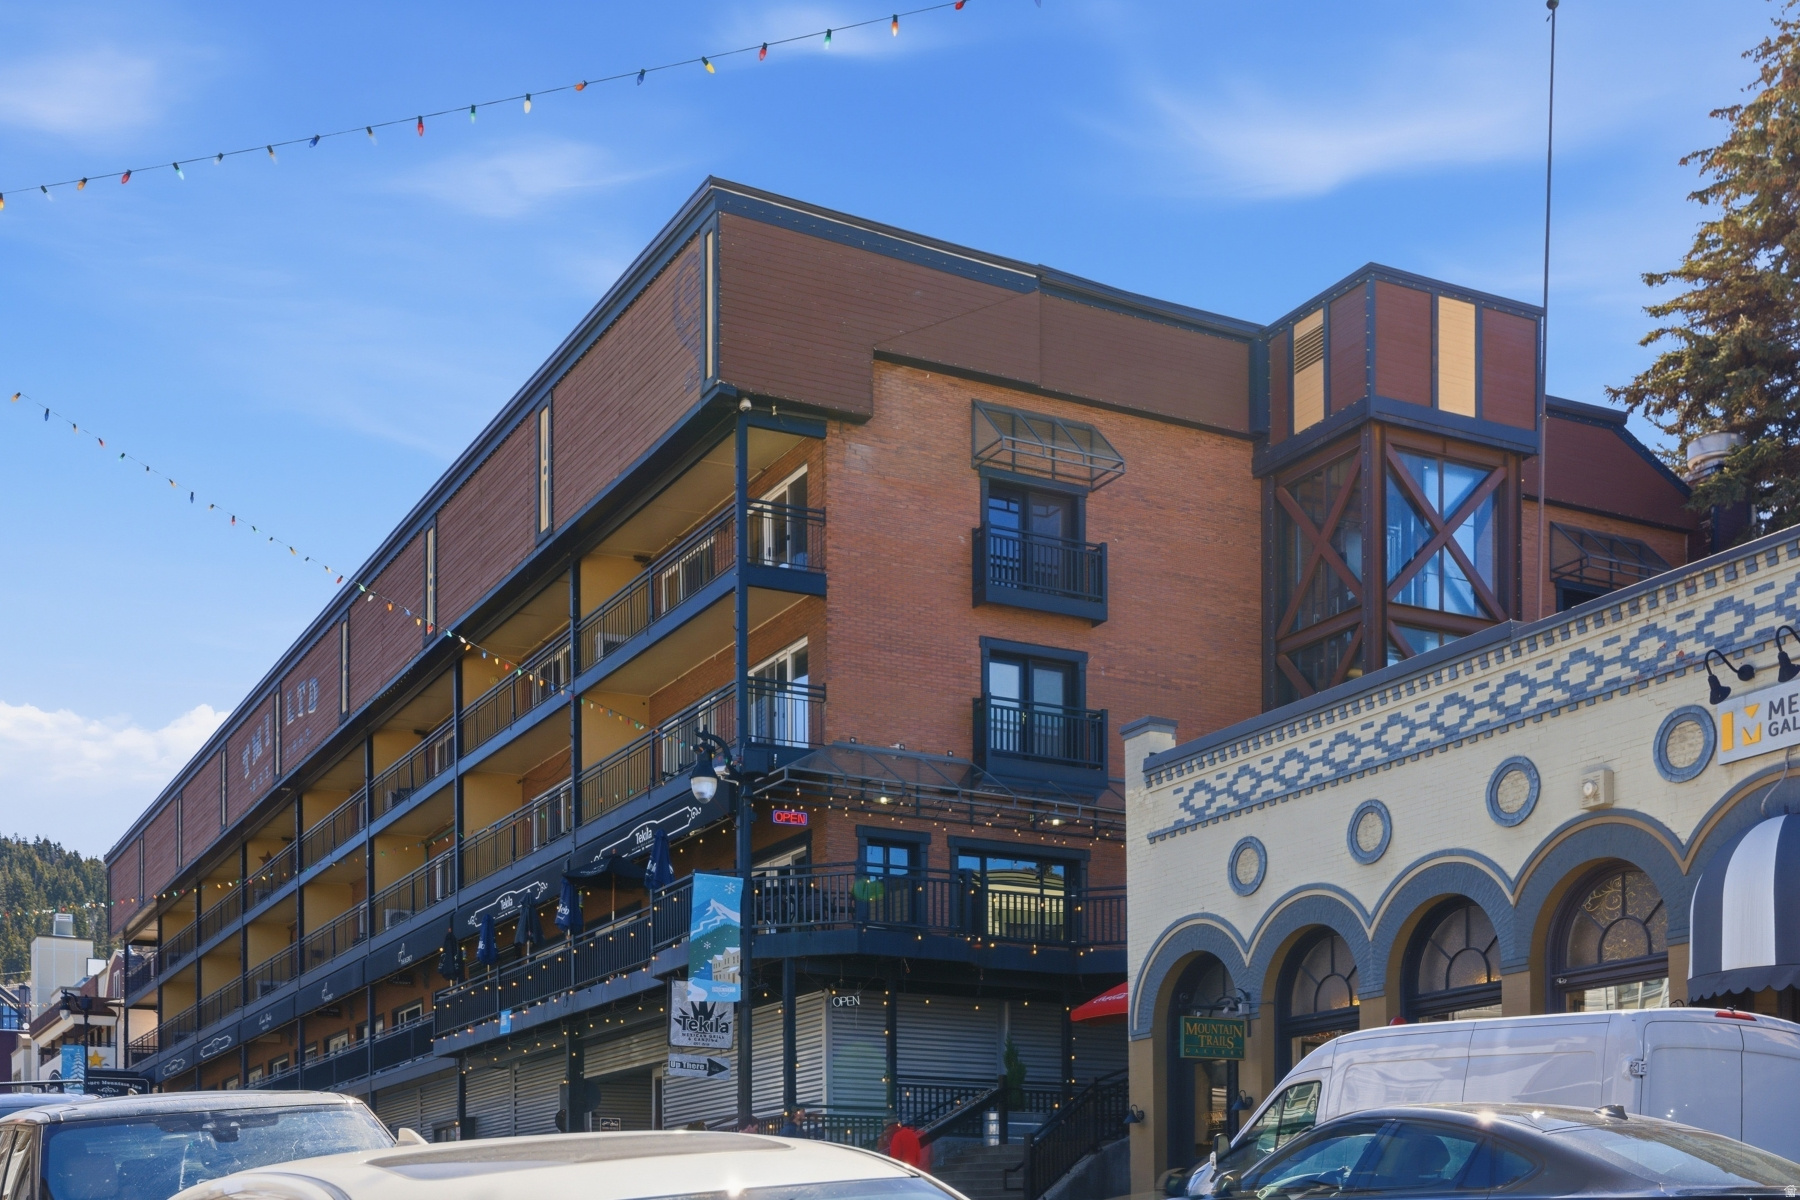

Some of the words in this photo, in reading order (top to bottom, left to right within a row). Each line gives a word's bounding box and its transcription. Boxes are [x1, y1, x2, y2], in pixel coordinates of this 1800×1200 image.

[286, 677, 319, 726] LTD
[1768, 693, 1800, 720] ME
[1768, 716, 1800, 736] GAL
[775, 812, 806, 824] OPEN
[833, 996, 860, 1007] OPEN
[679, 1015, 729, 1034] Tekila
[1185, 1022, 1243, 1037] MOUNTAIN
[1198, 1034, 1234, 1049] TRAILS
[670, 1060, 681, 1069] Up
[682, 1061, 705, 1070] There
